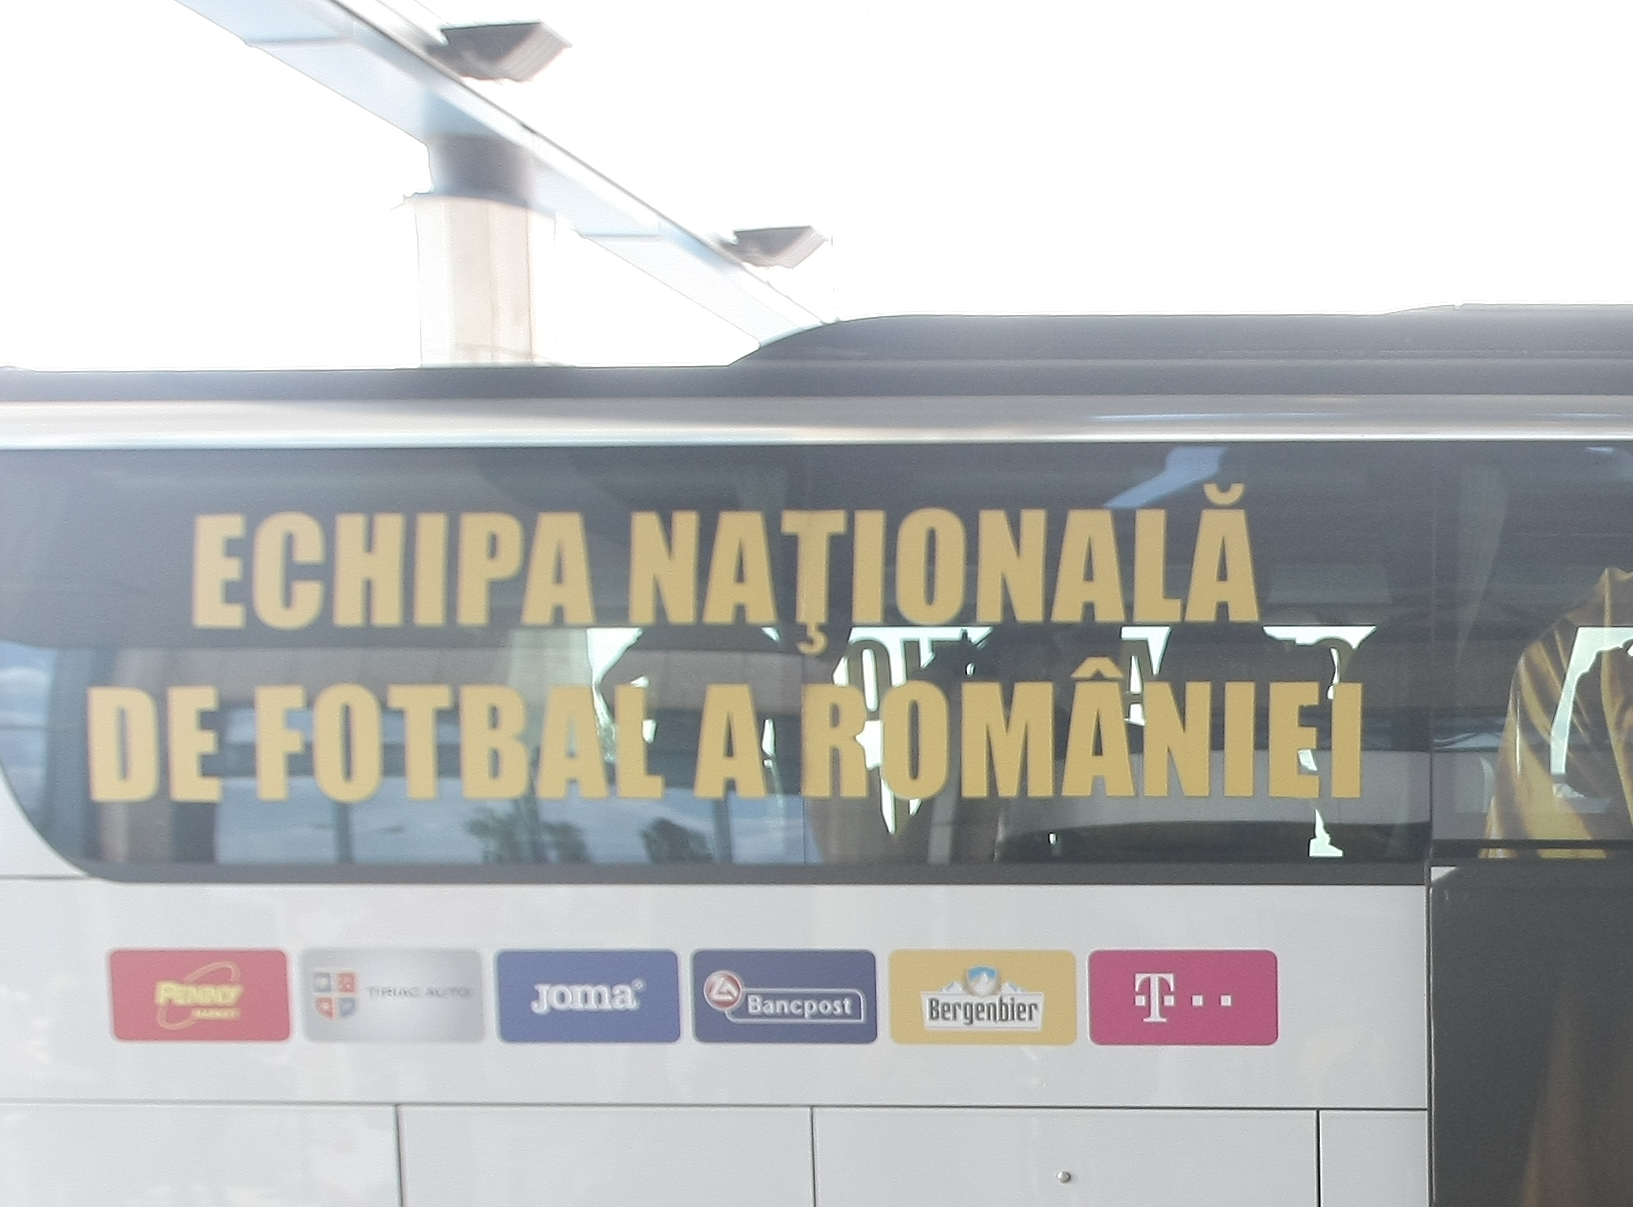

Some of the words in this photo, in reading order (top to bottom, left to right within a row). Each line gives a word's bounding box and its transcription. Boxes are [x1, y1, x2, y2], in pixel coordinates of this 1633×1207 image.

[192, 511, 594, 630] ECHIPA
[87, 685, 223, 803] DE
[255, 682, 664, 804] FOTBAL
[694, 682, 768, 798] A
[800, 656, 1362, 799] ROMÂNIEI
[747, 994, 853, 1020] Bancpost
[927, 995, 1039, 1025] Bergenbier
